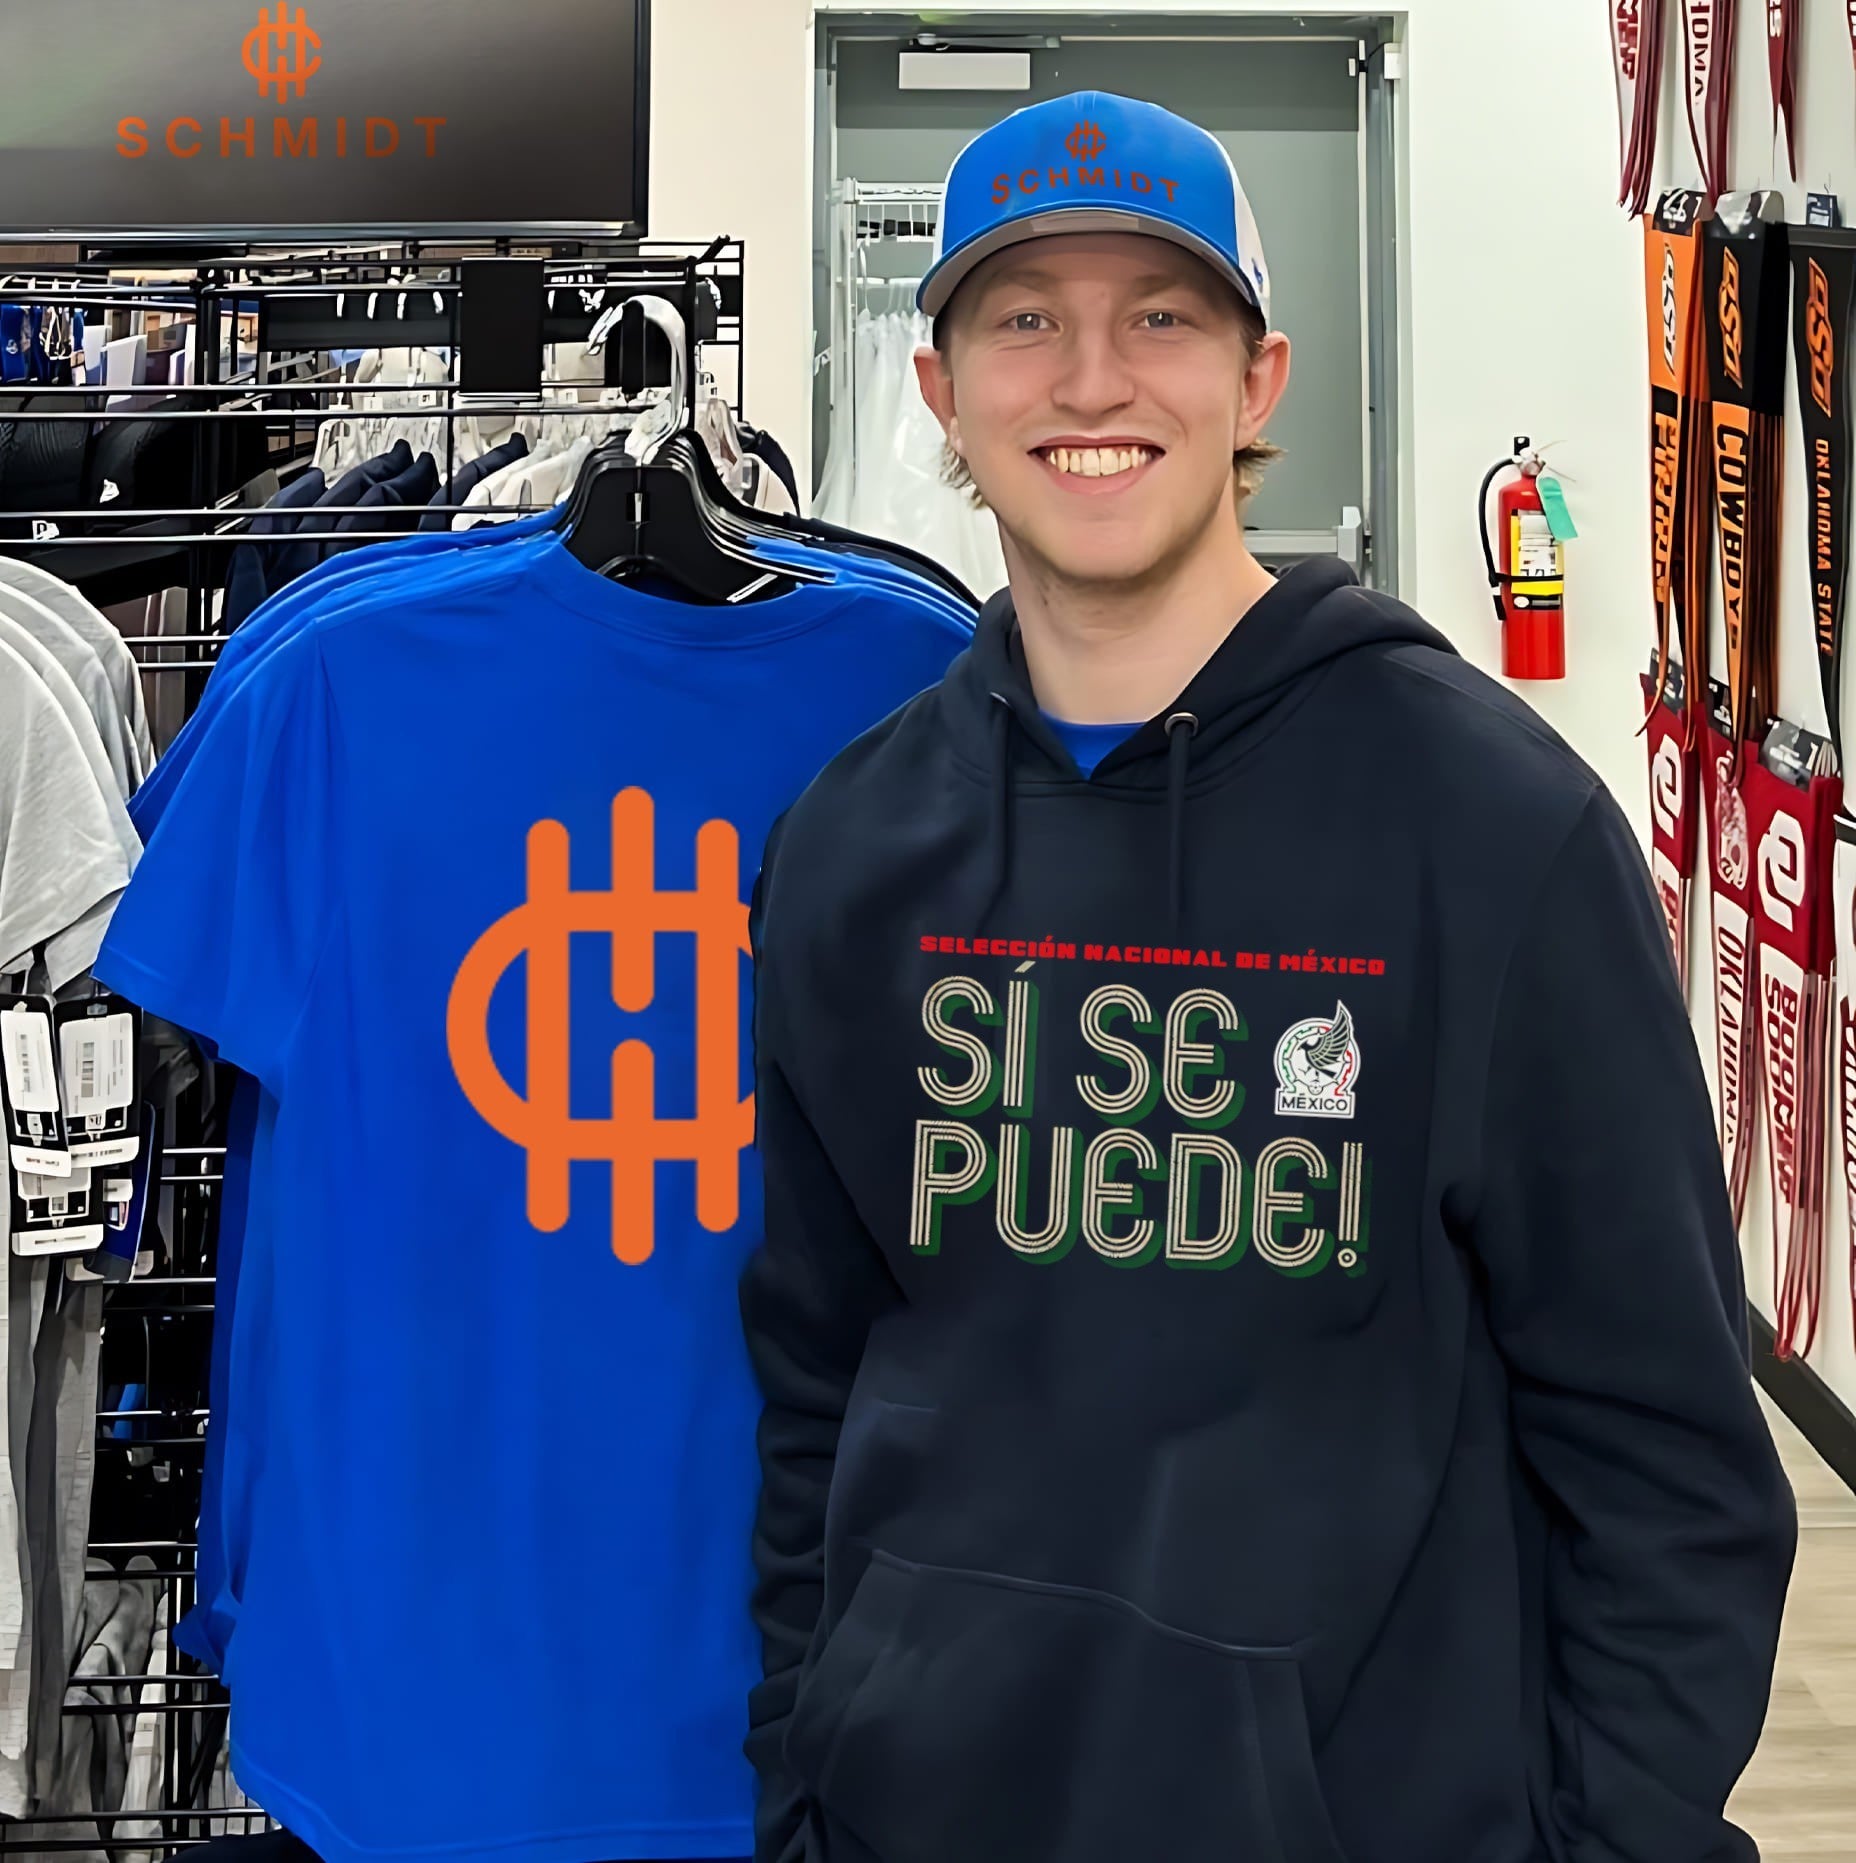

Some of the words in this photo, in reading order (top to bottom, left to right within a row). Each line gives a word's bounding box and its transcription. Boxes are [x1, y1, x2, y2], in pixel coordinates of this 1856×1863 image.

[115, 115, 448, 160] SCHMIDT
[991, 166, 1179, 204] SCHMIDT
[919, 935, 1077, 960] SELECCIÓN
[1083, 943, 1227, 968] NACIONAL
[1235, 951, 1271, 970] DE
[1279, 948, 1386, 976] MÉXICO
[917, 961, 1036, 1107] SÍ
[1076, 984, 1238, 1119] SE
[1281, 1093, 1348, 1111] MÉXICO
[909, 1119, 1363, 1269] PUEDE!
